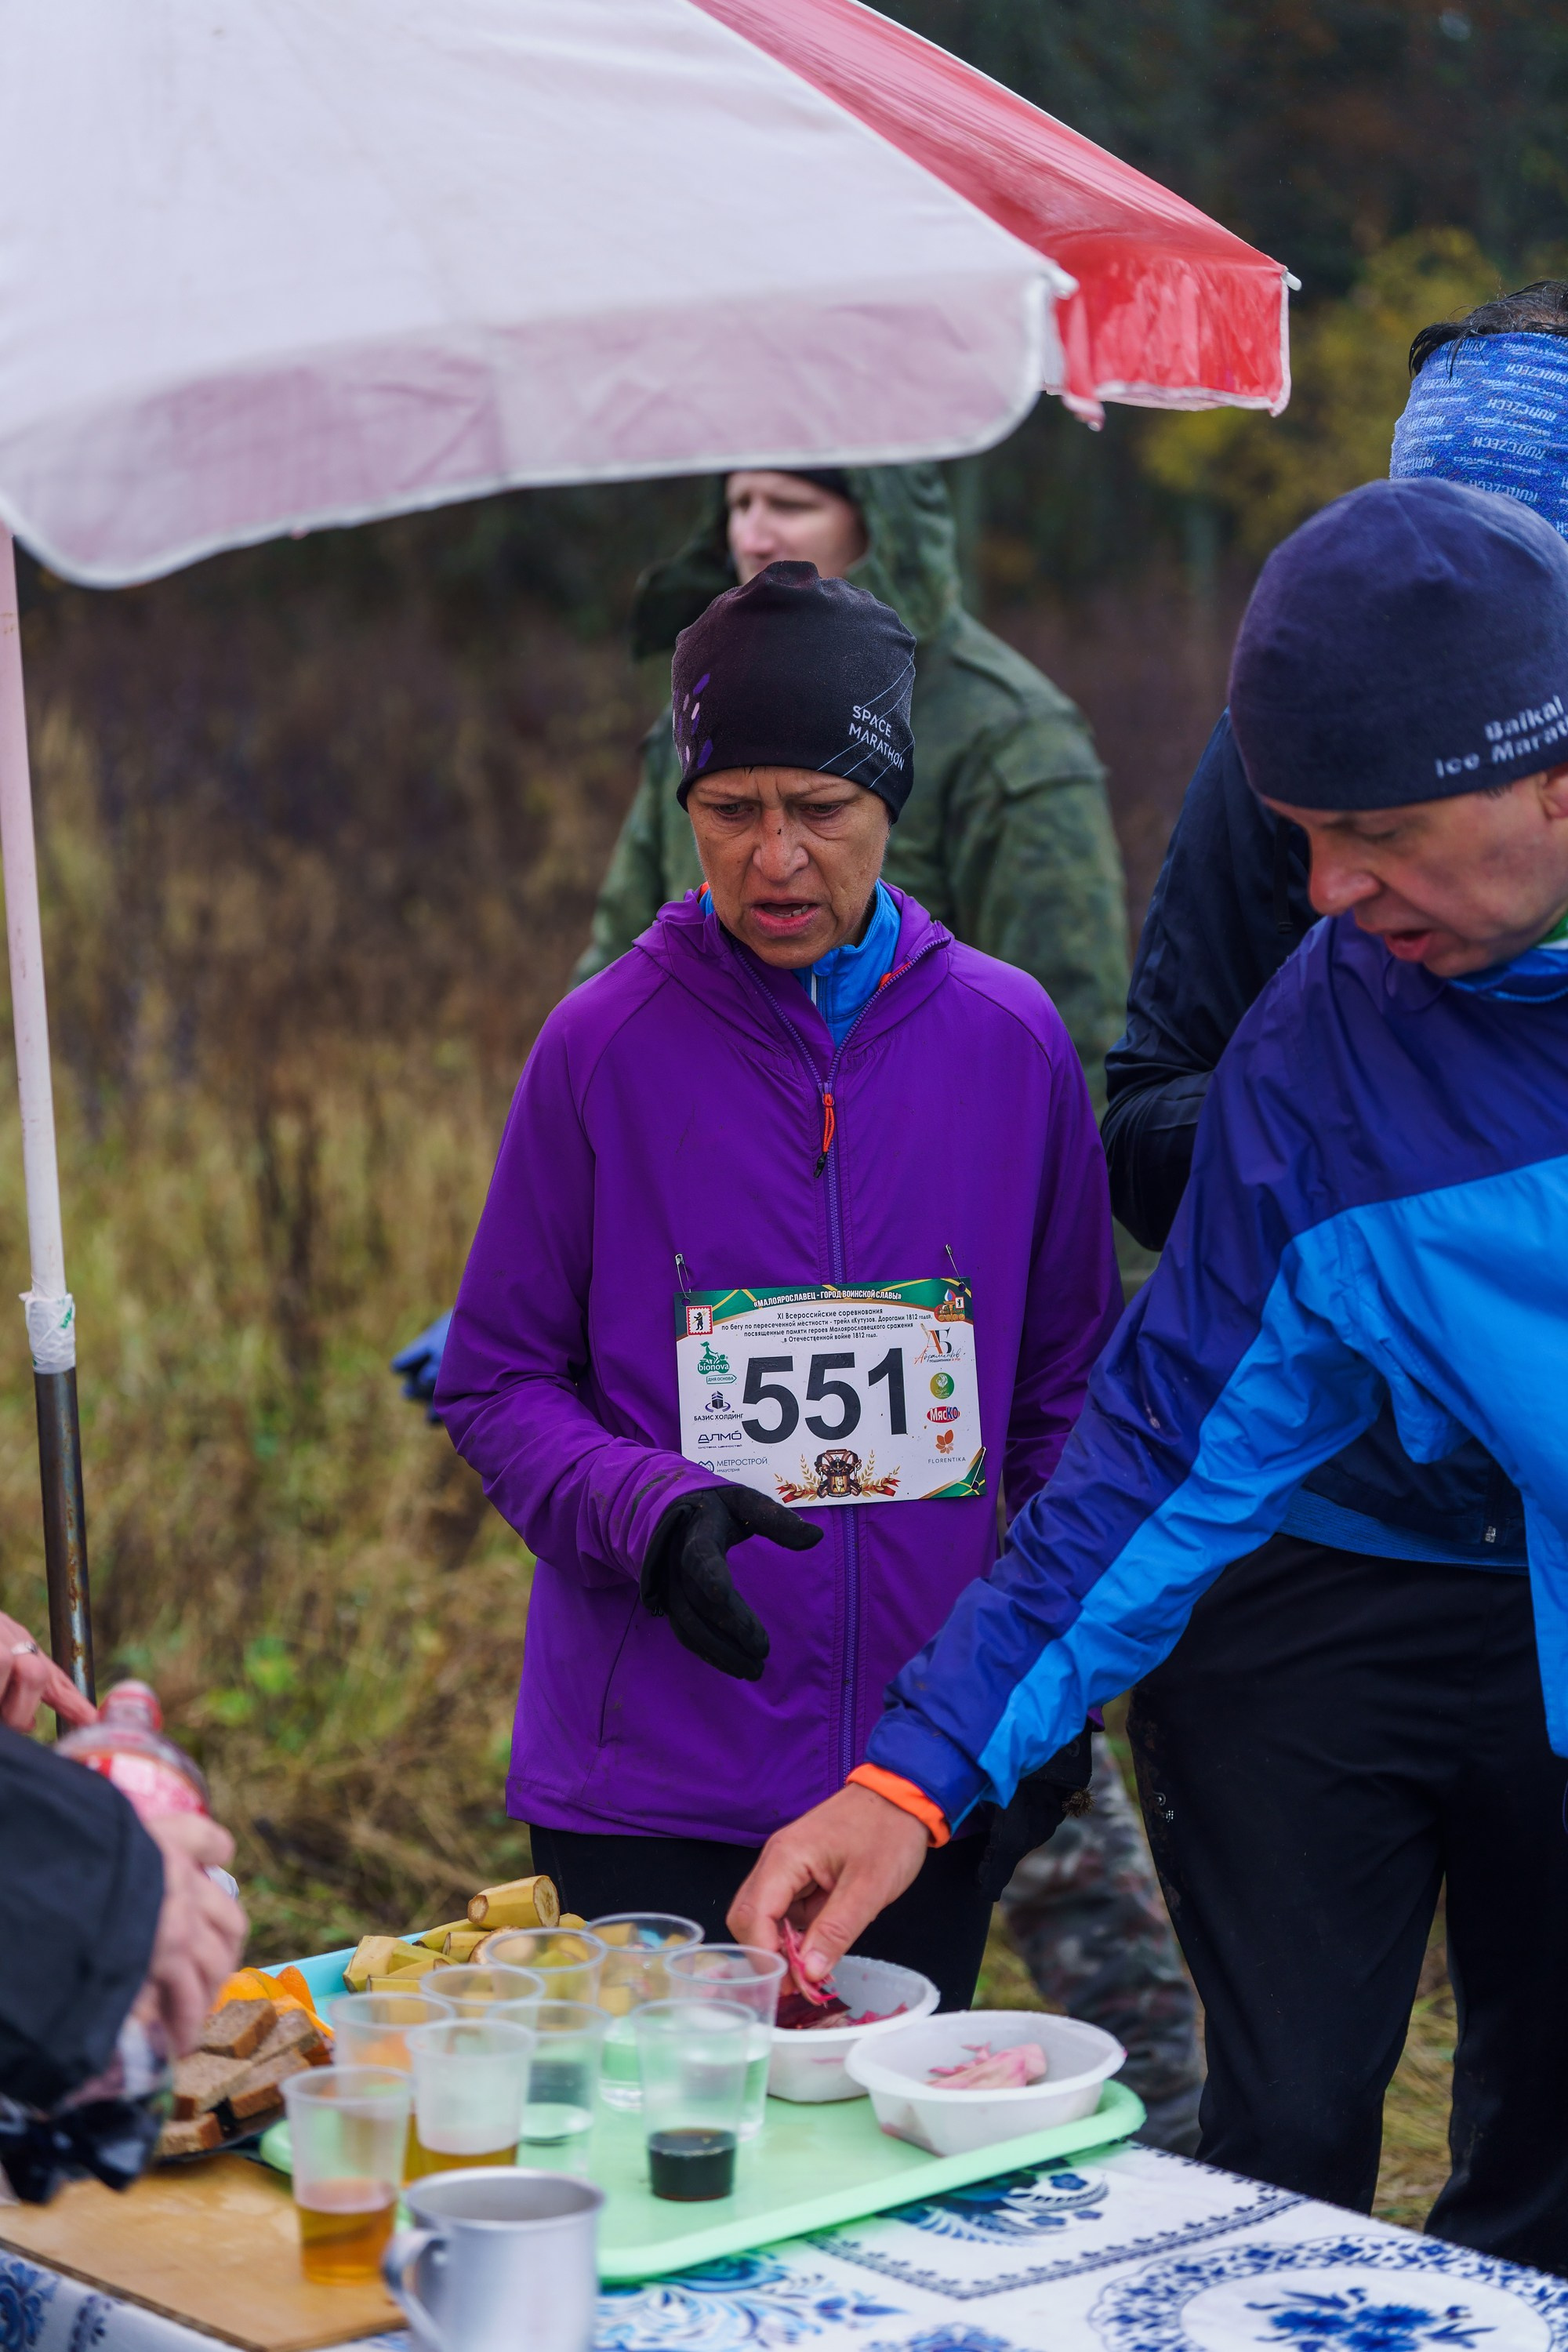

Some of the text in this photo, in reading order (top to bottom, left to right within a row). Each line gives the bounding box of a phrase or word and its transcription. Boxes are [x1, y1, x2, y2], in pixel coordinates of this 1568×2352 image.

[852, 706, 892, 738] SPACE
[1484, 695, 1565, 742] Baikal
[848, 723, 906, 771] MARATHON
[1434, 714, 1568, 779] Ice Marat
[820, 1290, 841, 1299] ГОРОД
[842, 1290, 876, 1298] ВОИНСКОЙ
[876, 1290, 902, 1300] СЛАВЫ»
[785, 1310, 837, 1320] Всероссийские
[838, 1308, 883, 1318] соревнования
[753, 1321, 796, 1330] пересеченной
[877, 1315, 906, 1323] Дорогами
[829, 1324, 886, 1333] Малоярославецкого
[788, 1334, 833, 1342] Отечественной
[698, 1363, 730, 1371] bionova
[741, 1347, 908, 1444] 551
[717, 1457, 768, 1467] МЕТРОСТРОЙ
